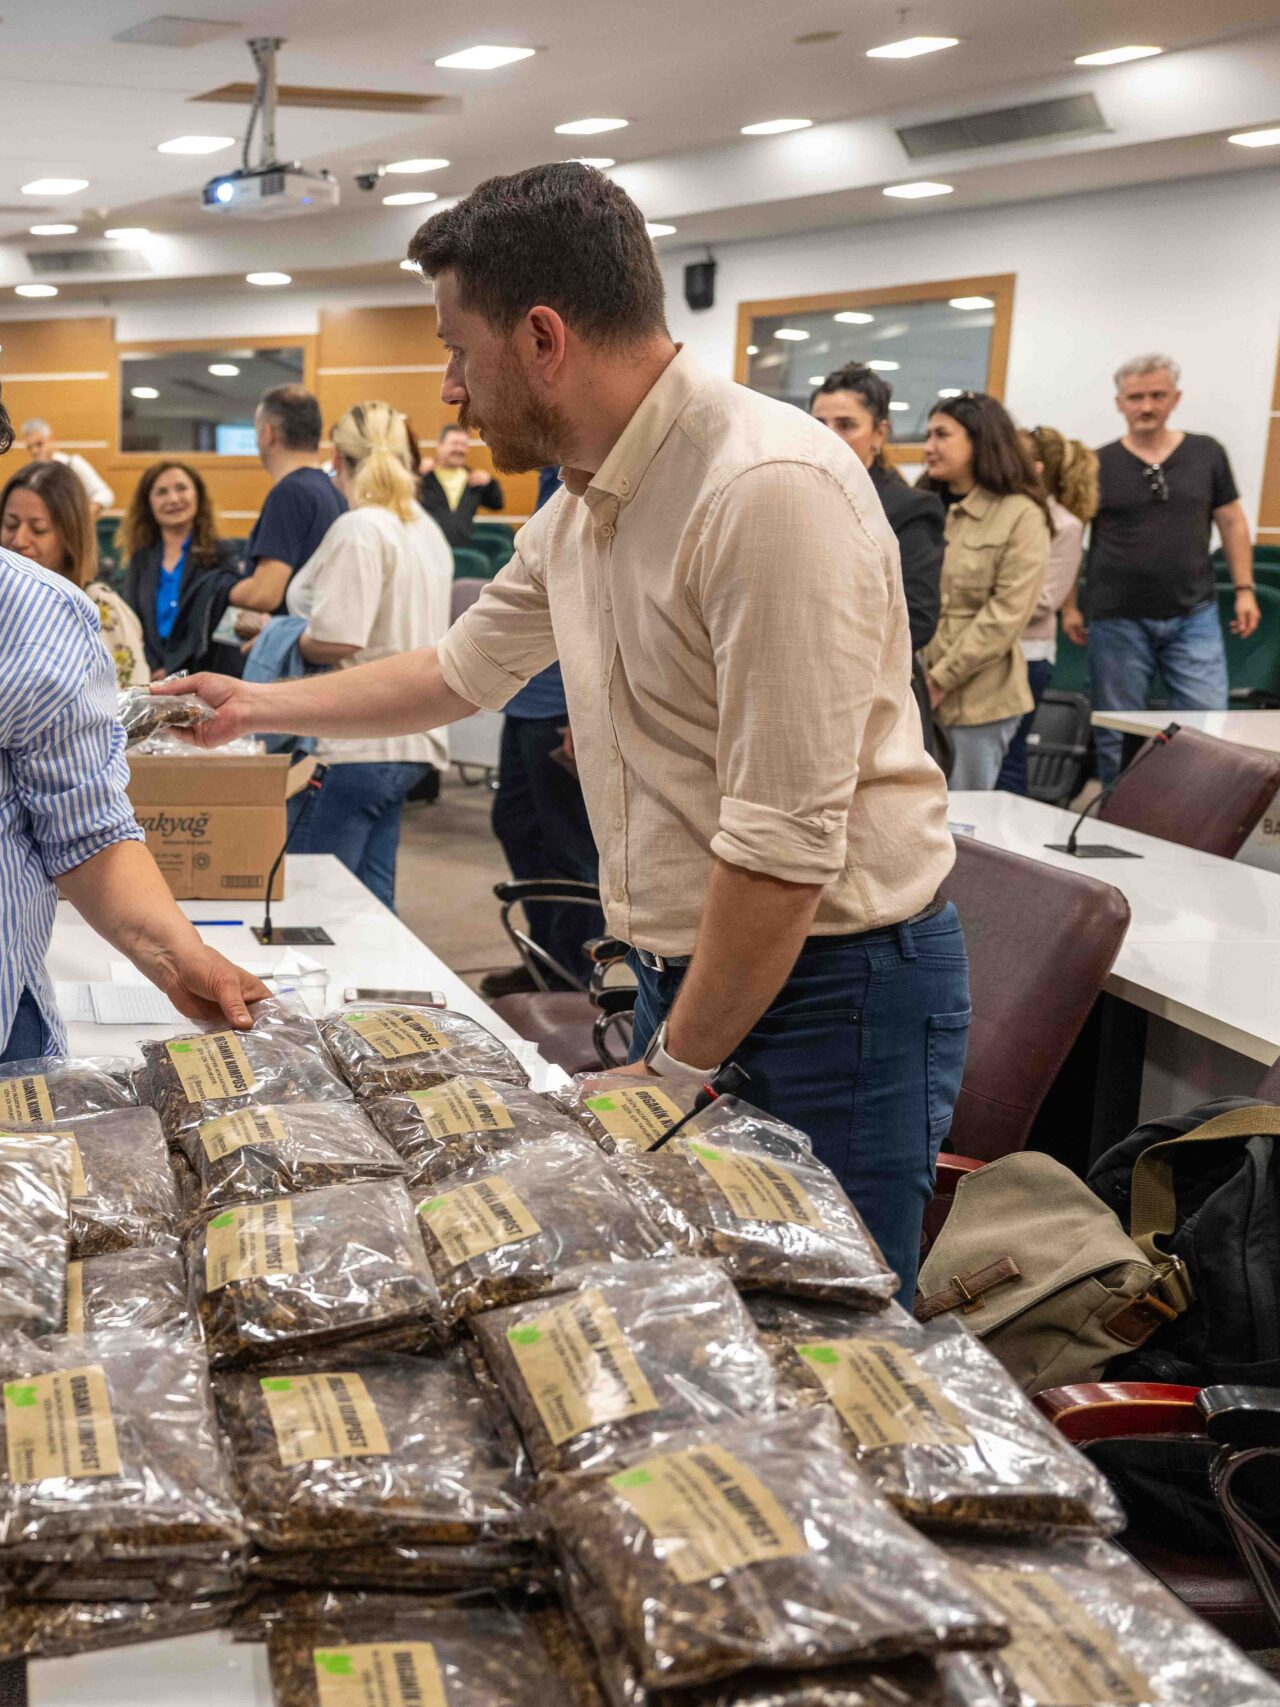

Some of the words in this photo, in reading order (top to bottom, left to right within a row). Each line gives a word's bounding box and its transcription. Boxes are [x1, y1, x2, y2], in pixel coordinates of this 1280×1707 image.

[134, 811, 211, 837] rakyağ
[193, 1079, 207, 1099] Bornova
[224, 1059, 248, 1093] KOMPOST
[634, 1090, 671, 1119] ORGANİK
